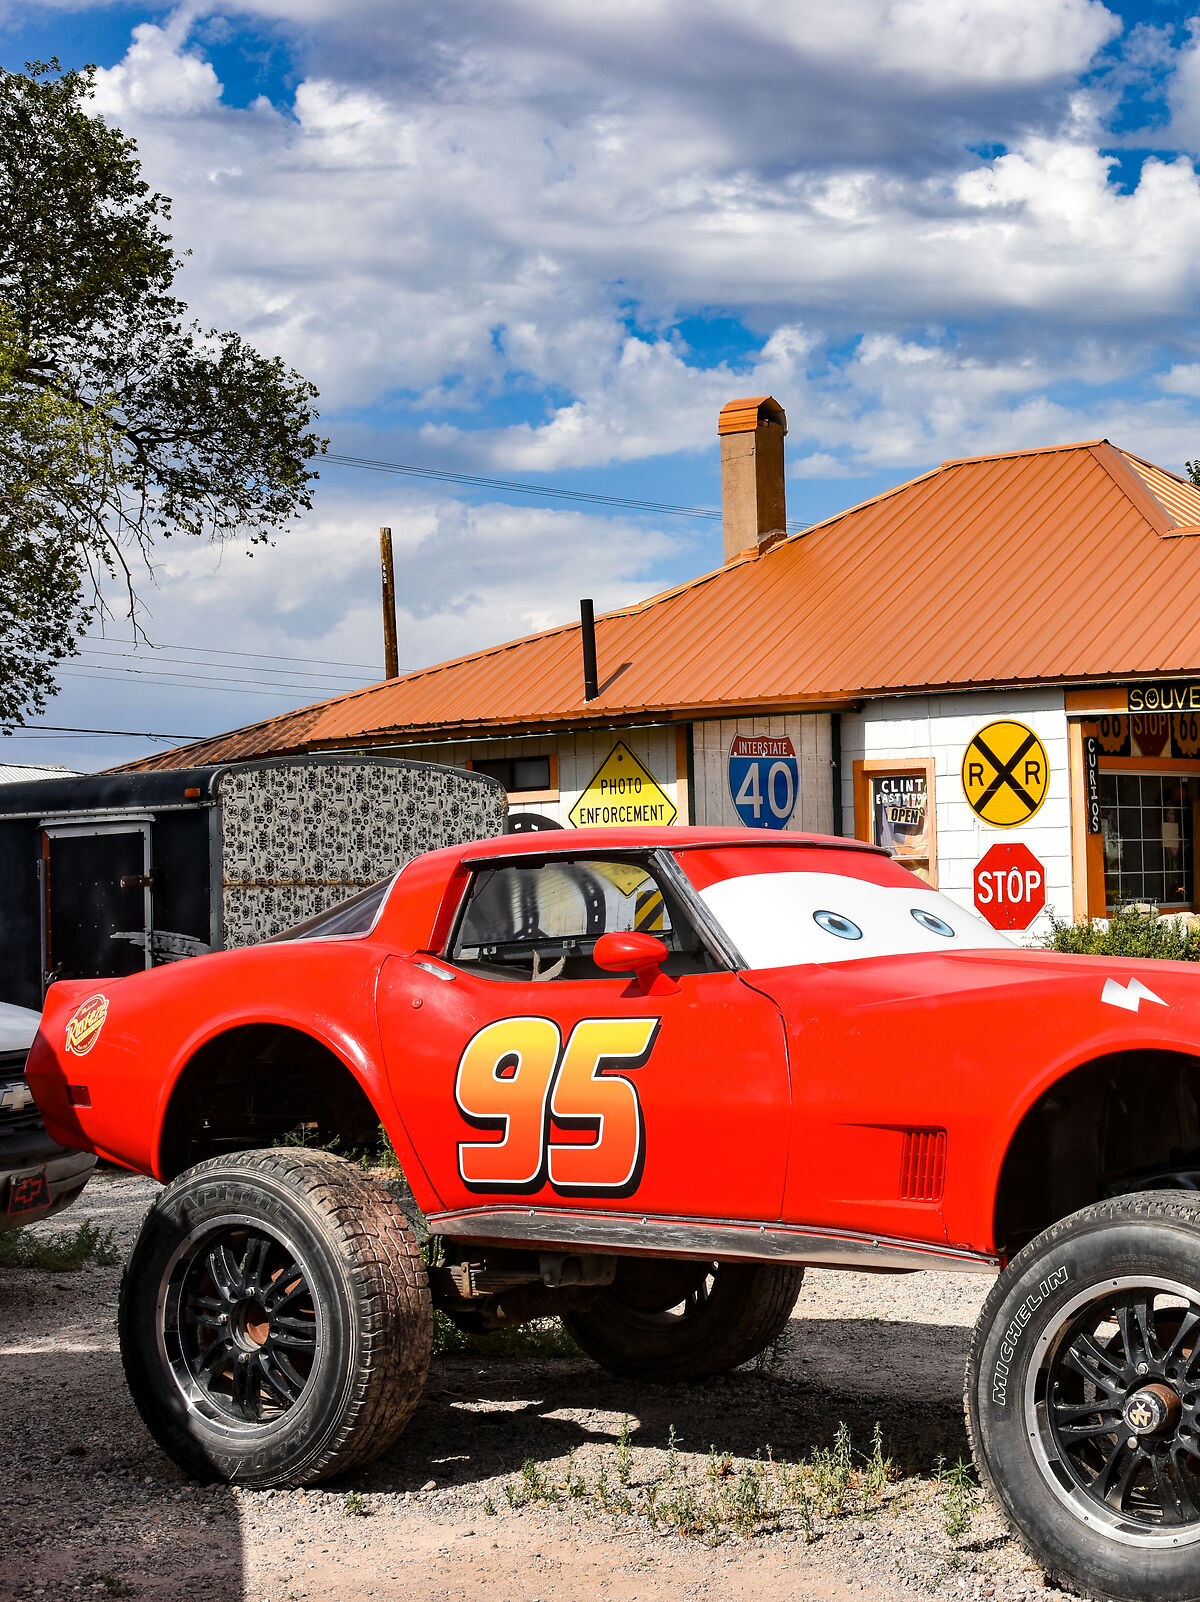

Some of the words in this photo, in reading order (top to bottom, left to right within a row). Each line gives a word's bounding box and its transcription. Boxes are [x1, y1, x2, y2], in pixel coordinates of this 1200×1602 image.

[1135, 713, 1168, 736] STOP
[1180, 713, 1198, 742] 66
[738, 740, 788, 756] INTERSTATE
[600, 777, 643, 796] PHOTO
[735, 761, 793, 819] 40
[881, 778, 924, 793] CLINT
[1087, 738, 1100, 833] CURIOS
[579, 804, 665, 825] ENFORCEMENT
[890, 808, 919, 824] OPEN
[453, 1015, 663, 1200] 95
[992, 1265, 1069, 1406] MICHELIN
